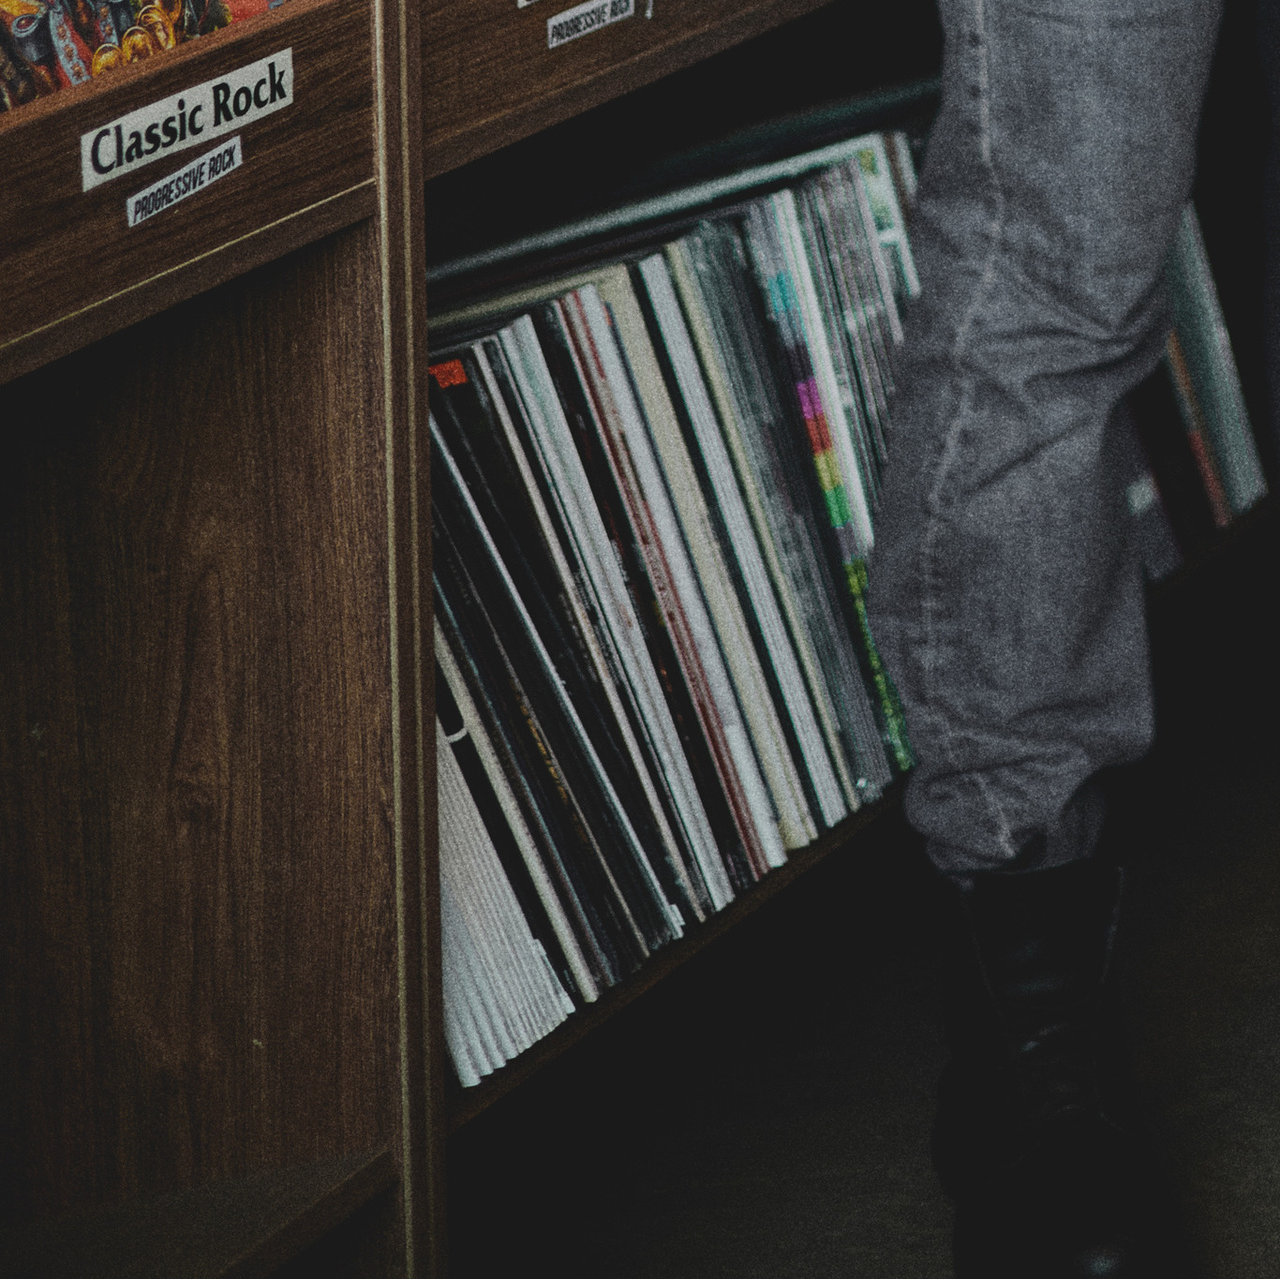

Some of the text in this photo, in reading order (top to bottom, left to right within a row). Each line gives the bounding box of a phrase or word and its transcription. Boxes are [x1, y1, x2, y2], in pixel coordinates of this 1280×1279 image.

[550, 3, 609, 45] PROGRESSIVE
[91, 61, 287, 176] Classic Rock
[133, 144, 237, 224] PROGRESSIVE ROCK
